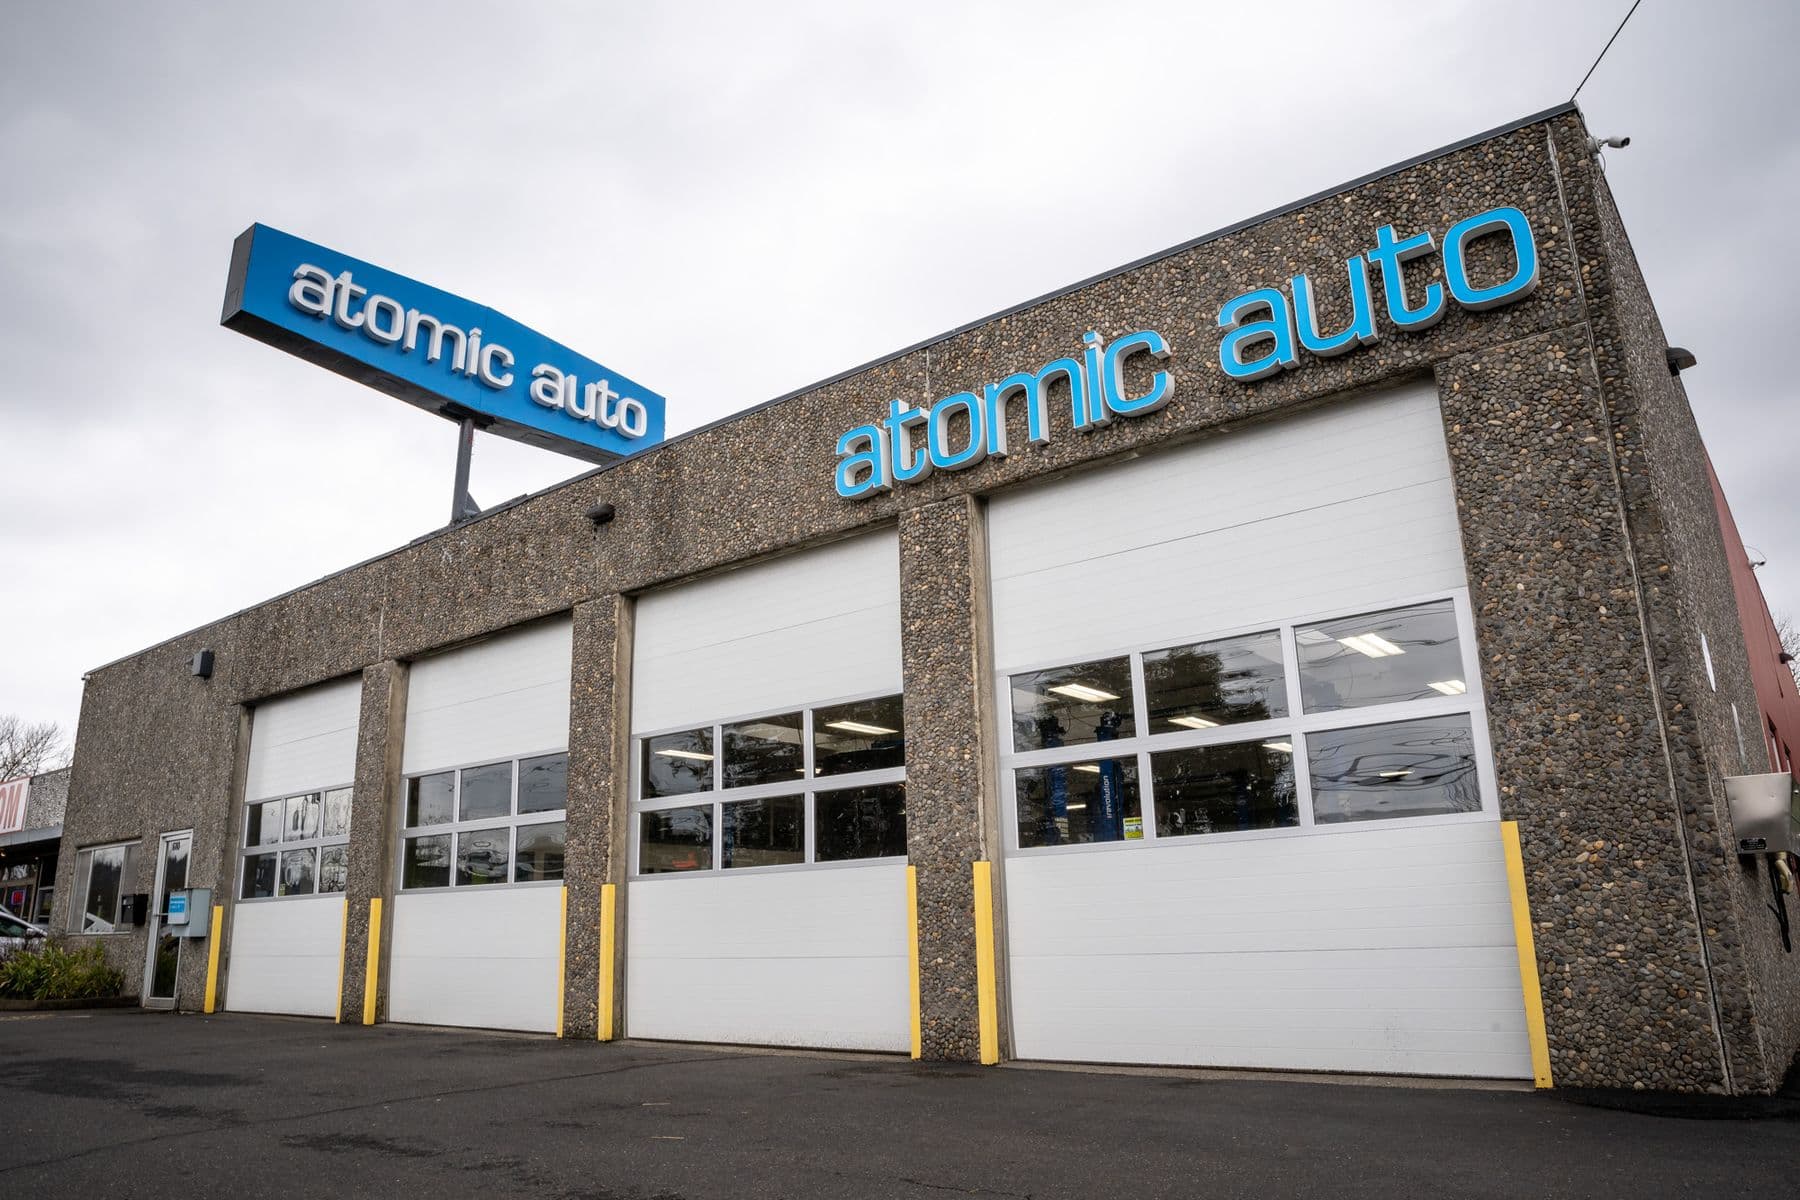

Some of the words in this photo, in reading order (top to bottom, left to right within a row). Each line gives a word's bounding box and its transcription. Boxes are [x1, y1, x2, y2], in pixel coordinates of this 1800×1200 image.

[289, 263, 514, 389] atomic
[530, 362, 647, 440] auto
[835, 330, 1175, 499] atomic
[1217, 206, 1540, 383] auto
